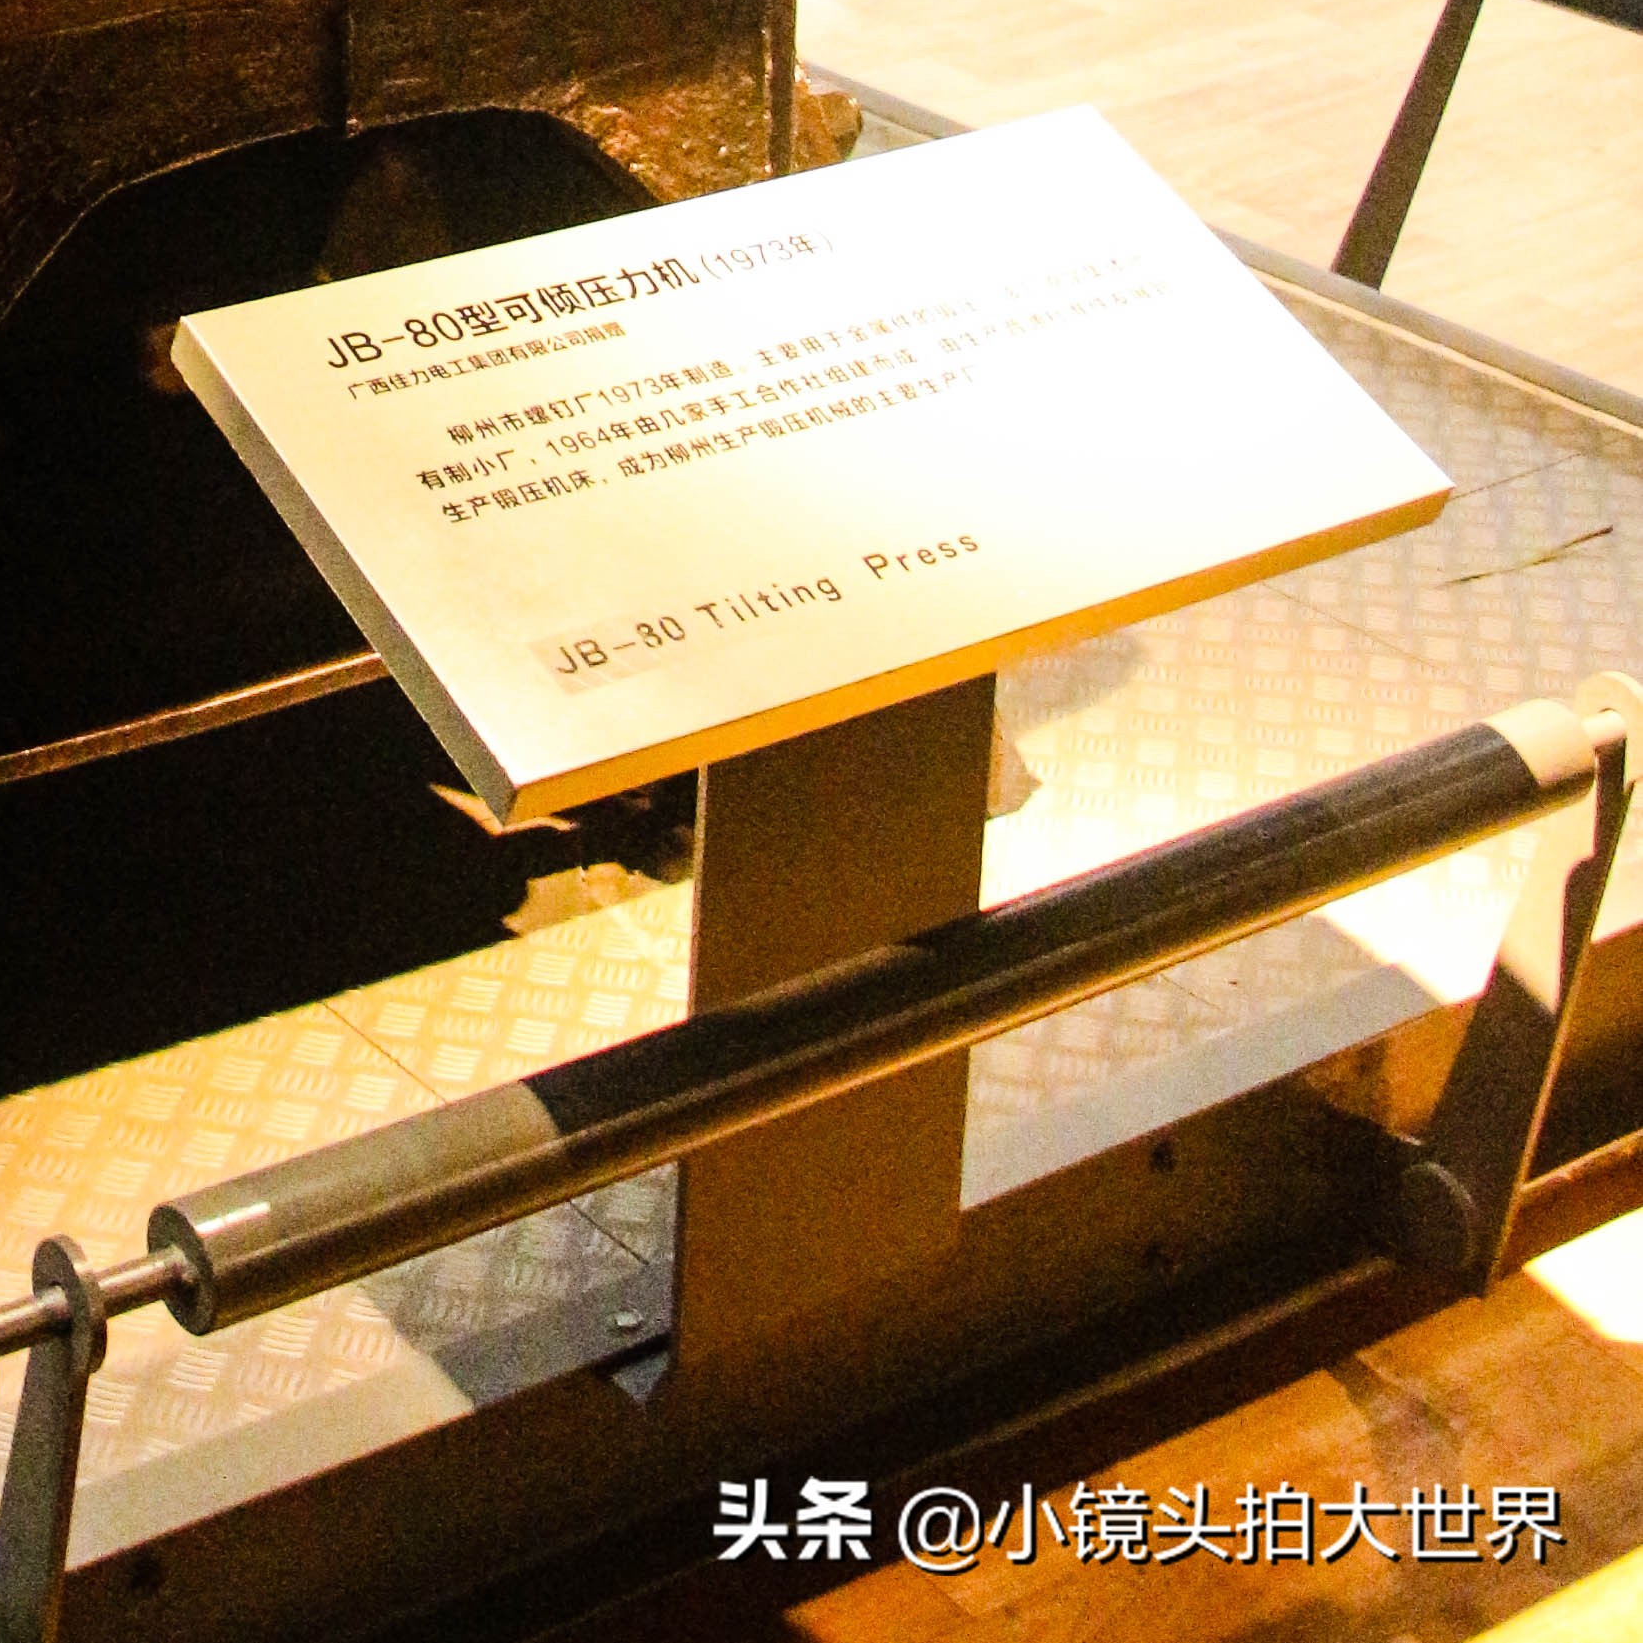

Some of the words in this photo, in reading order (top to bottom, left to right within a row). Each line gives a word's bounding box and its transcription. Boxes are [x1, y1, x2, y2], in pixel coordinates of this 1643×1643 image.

[344, 322, 629, 401] 广西佳力电工集团有限公司捐赠
[694, 574, 843, 630] Tilting
[861, 531, 981, 581] Press
